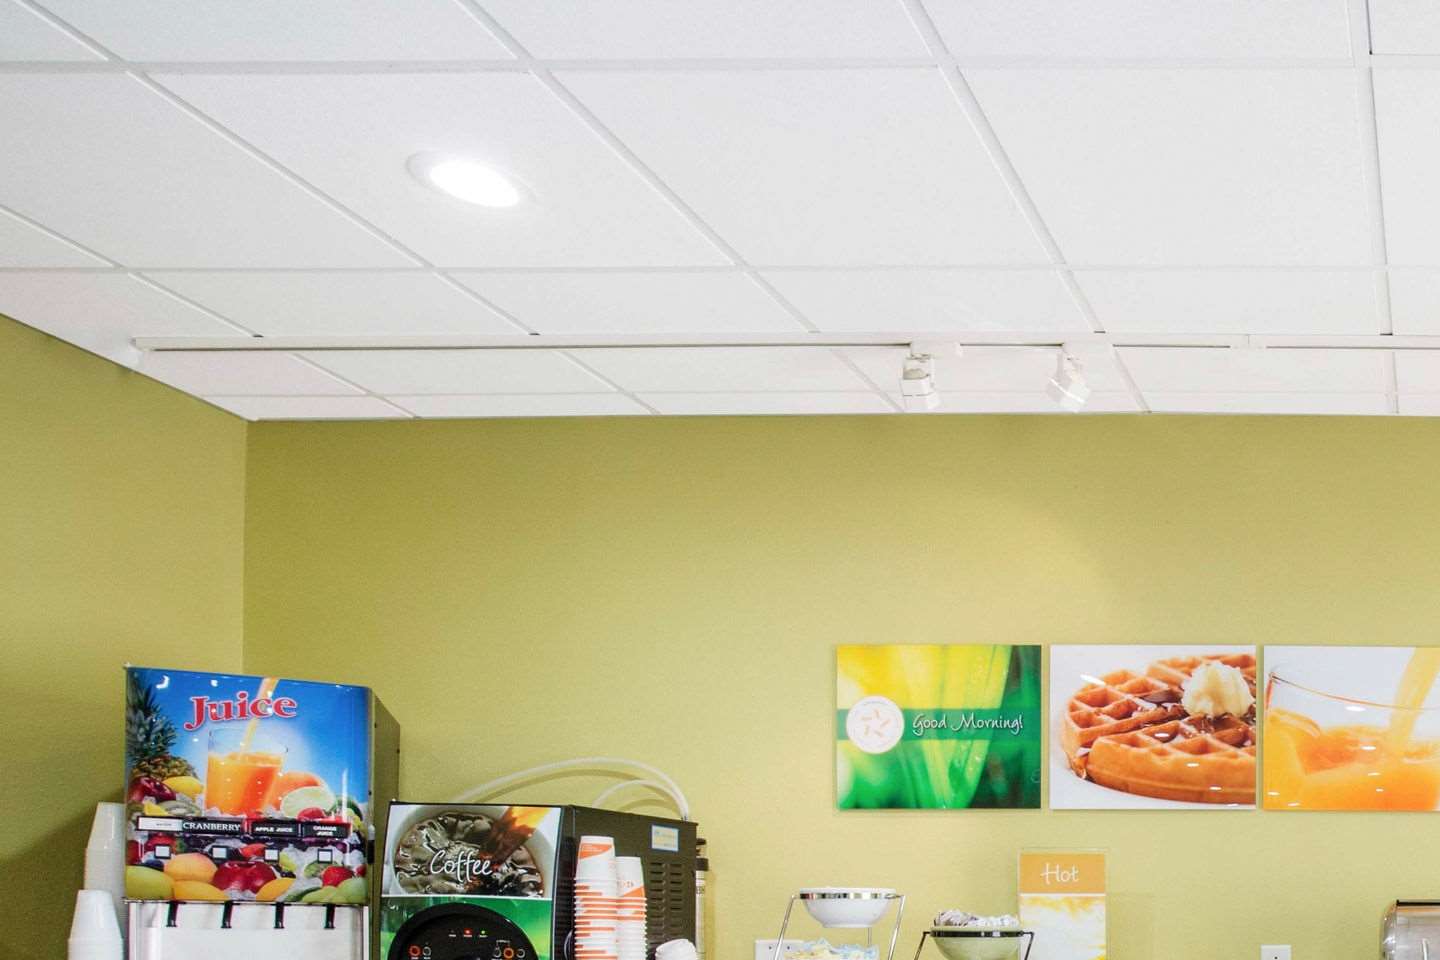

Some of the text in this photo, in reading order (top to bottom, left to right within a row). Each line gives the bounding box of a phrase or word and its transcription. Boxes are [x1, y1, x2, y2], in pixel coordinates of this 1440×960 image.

[184, 690, 297, 731] Juice
[912, 712, 1024, 736] Good Morning!
[182, 822, 241, 831] CRANBERRY
[430, 849, 493, 883] Coffee
[1040, 862, 1080, 885] Hot
